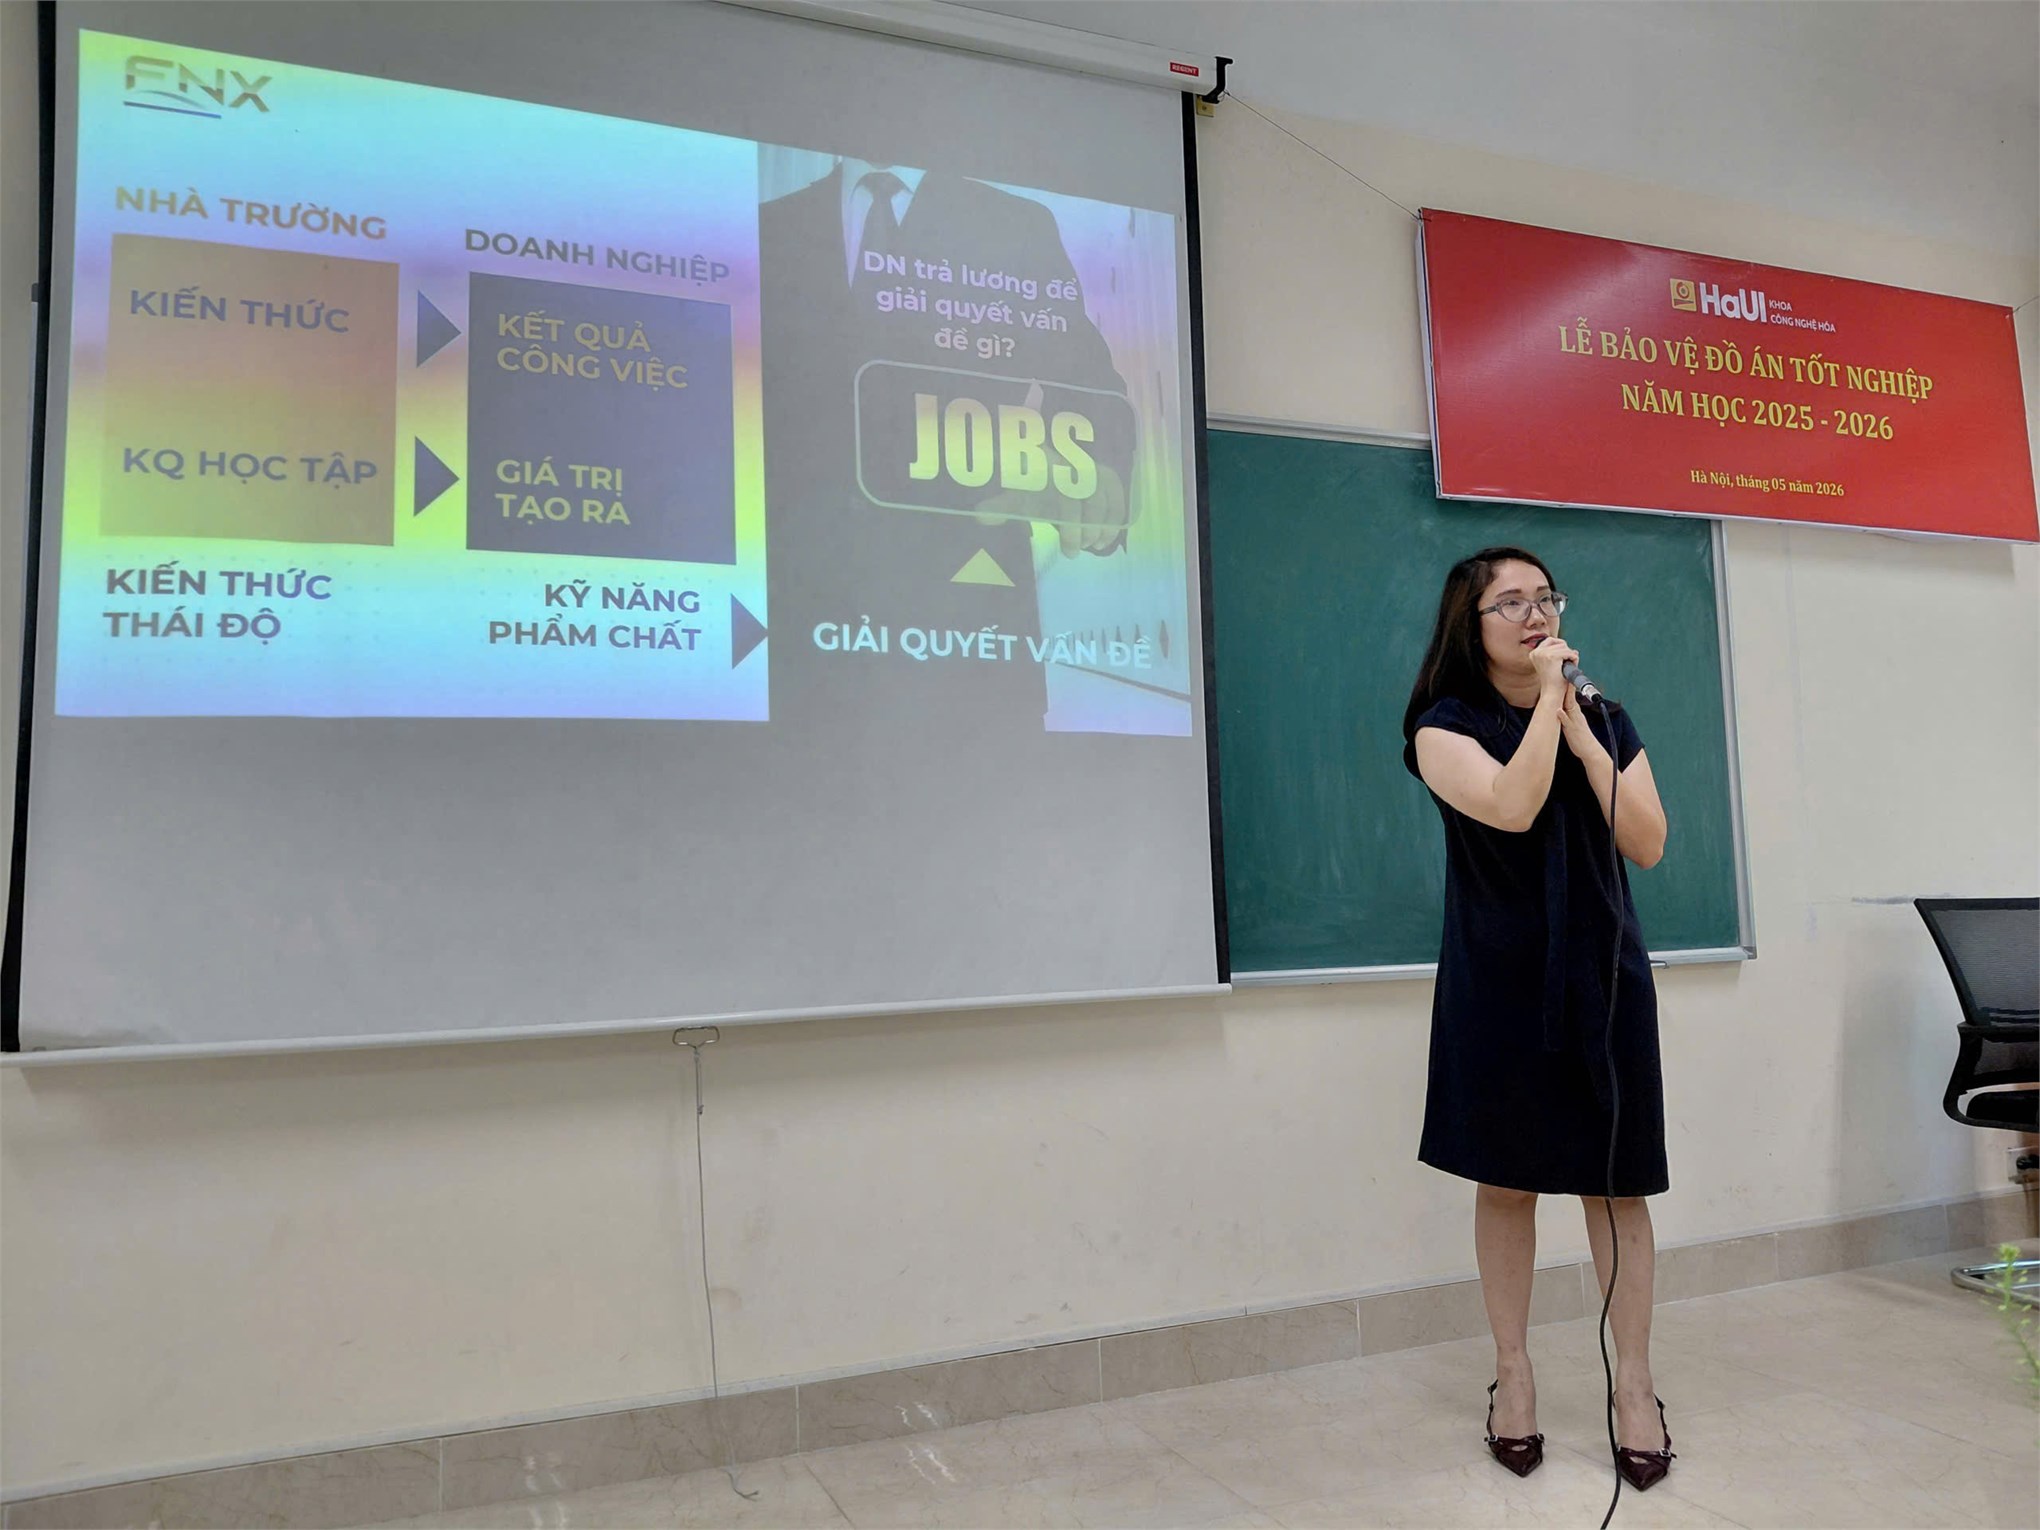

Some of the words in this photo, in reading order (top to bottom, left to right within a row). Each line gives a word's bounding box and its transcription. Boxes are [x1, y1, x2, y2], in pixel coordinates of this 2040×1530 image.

[125, 55, 273, 113] FNX
[115, 186, 209, 219] NHÀ
[219, 198, 388, 240] TRƯỜNG
[465, 229, 594, 265] DOANH
[606, 247, 730, 287] NGHIỆP
[863, 251, 906, 276] DN
[914, 259, 953, 283] trả
[961, 264, 1038, 300] lương
[1045, 278, 1079, 300] để
[130, 286, 227, 321] KIẾN
[240, 299, 350, 333] THỨC
[876, 287, 927, 312] giải
[935, 299, 1014, 324] quyết
[1020, 307, 1067, 332] vấn
[1700, 282, 1767, 323] HaUI
[1769, 299, 1792, 312] KHOA
[1770, 313, 1793, 327] CÔNG
[1795, 318, 1817, 331] NGHỆ
[1818, 321, 1836, 333] HÓA
[498, 310, 565, 342] KẾT
[574, 320, 651, 352] QUẢ
[934, 328, 969, 350] đề
[976, 335, 1016, 359] gì?
[497, 344, 601, 379] CÔNG
[609, 357, 689, 391] VIỆC
[1558, 316, 1593, 355] LỄ
[1600, 327, 1658, 363] BẢO
[1664, 336, 1699, 375] VỆ
[1705, 340, 1743, 374] ĐỒ
[1750, 346, 1784, 380] ÁN
[1790, 353, 1840, 388] TỐT
[1846, 365, 1933, 404] NGHIỆP
[1621, 379, 1684, 416] NĂM
[1691, 392, 1747, 428] HỌC
[1752, 399, 1814, 431] 2025
[1834, 409, 1894, 440] 2026
[909, 393, 1098, 499] JOBS
[123, 448, 184, 480] KQ
[199, 451, 288, 485] HỌC
[300, 452, 377, 489] TẬP
[496, 457, 560, 487] GIÁ
[568, 464, 624, 497] TRỊ
[1691, 470, 1707, 483] Hà
[1710, 472, 1734, 488] Nội,
[1736, 474, 1770, 493] tháng
[1771, 478, 1786, 491] 05
[1789, 480, 1814, 494] năm
[1815, 481, 1845, 497] 2026
[495, 493, 571, 524] TẠO
[582, 500, 631, 525] RA
[107, 561, 206, 595] KIẾN
[219, 568, 332, 600] THỨC
[545, 579, 591, 608] KỸ
[602, 582, 700, 613] NĂNG
[103, 605, 204, 638] THÁI
[217, 607, 281, 645] ĐỘ
[489, 613, 597, 647] PHẨM
[608, 620, 701, 651] CHẤT
[813, 614, 888, 653] GIẢI
[900, 624, 1018, 661] QUYẾT
[1025, 632, 1096, 666] VẤN
[1106, 636, 1152, 669] ĐỀ
